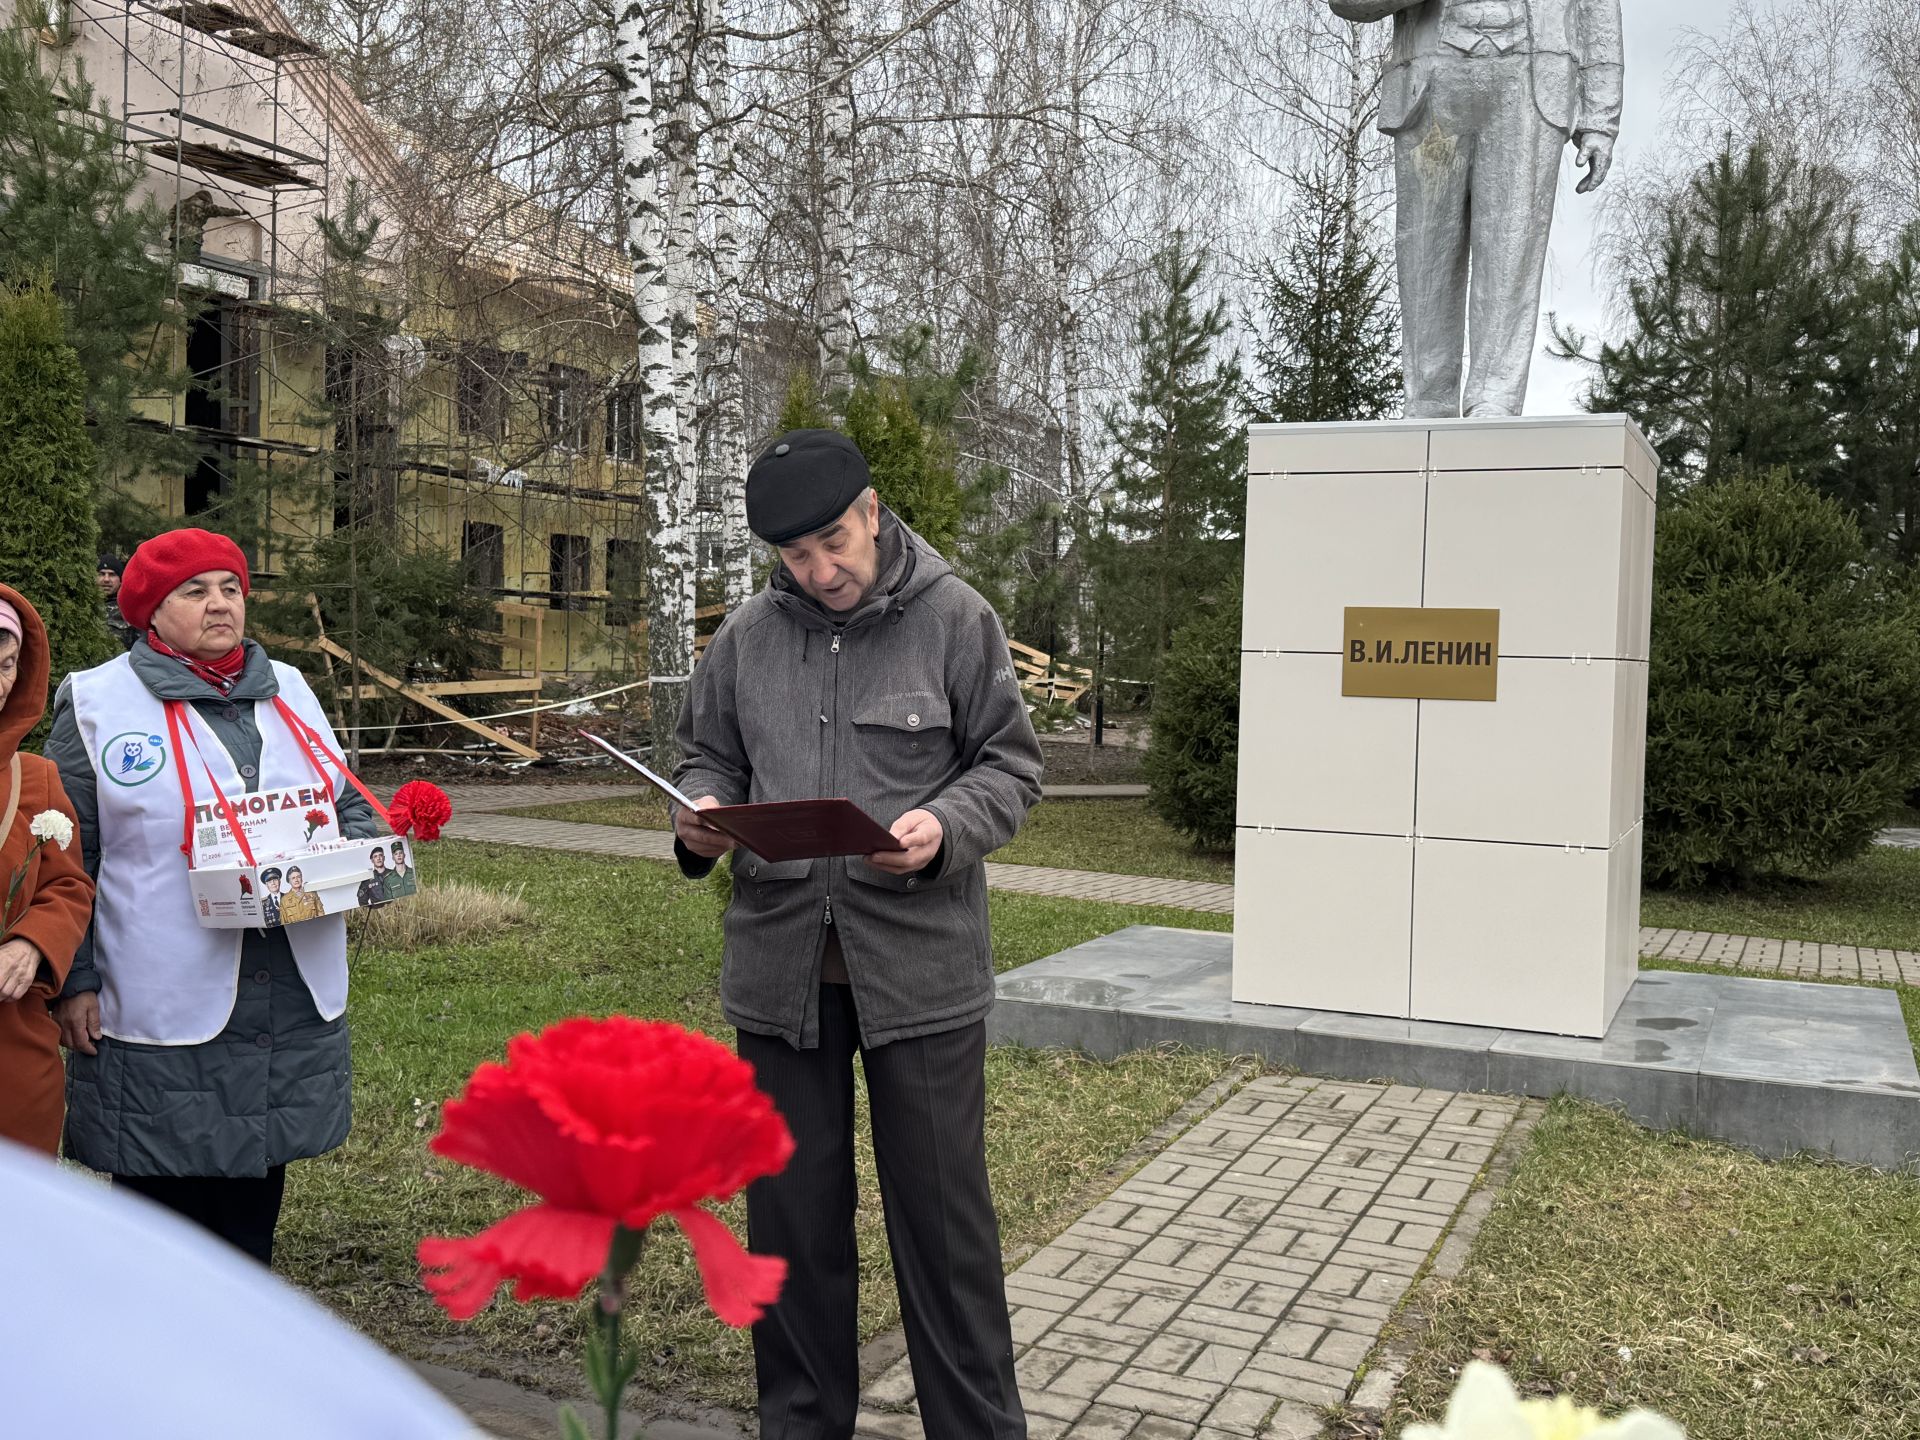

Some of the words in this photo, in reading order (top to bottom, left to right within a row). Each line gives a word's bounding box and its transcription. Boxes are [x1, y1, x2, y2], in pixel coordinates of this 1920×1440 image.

[1350, 639, 1492, 666] В.И.ЛЕНИН
[195, 785, 330, 824] ПОМОГАЕМ
[220, 818, 268, 832] ВЕРАНАМ
[221, 828, 253, 839] ВМТЕ
